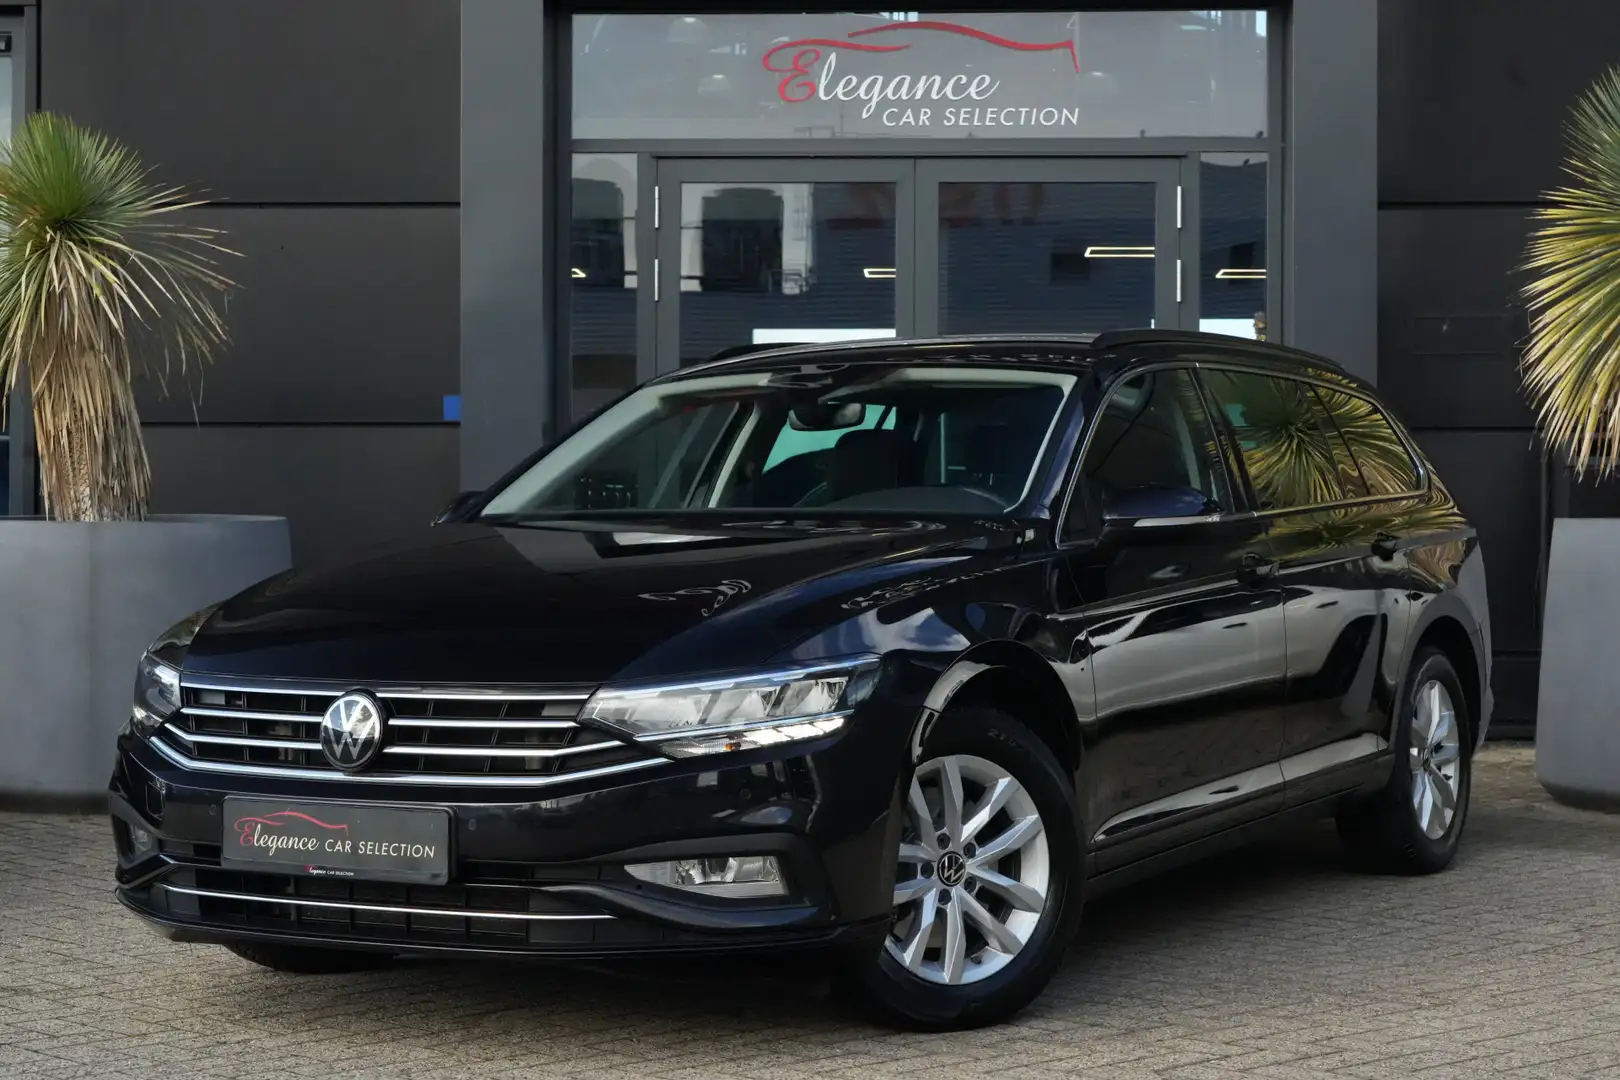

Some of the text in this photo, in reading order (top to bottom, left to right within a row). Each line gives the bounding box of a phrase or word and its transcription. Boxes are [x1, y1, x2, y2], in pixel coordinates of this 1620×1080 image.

[763, 39, 999, 119] Elegance
[883, 107, 1079, 126] CAR SELECTION
[234, 817, 436, 859] Elegance CAR SELECTION
